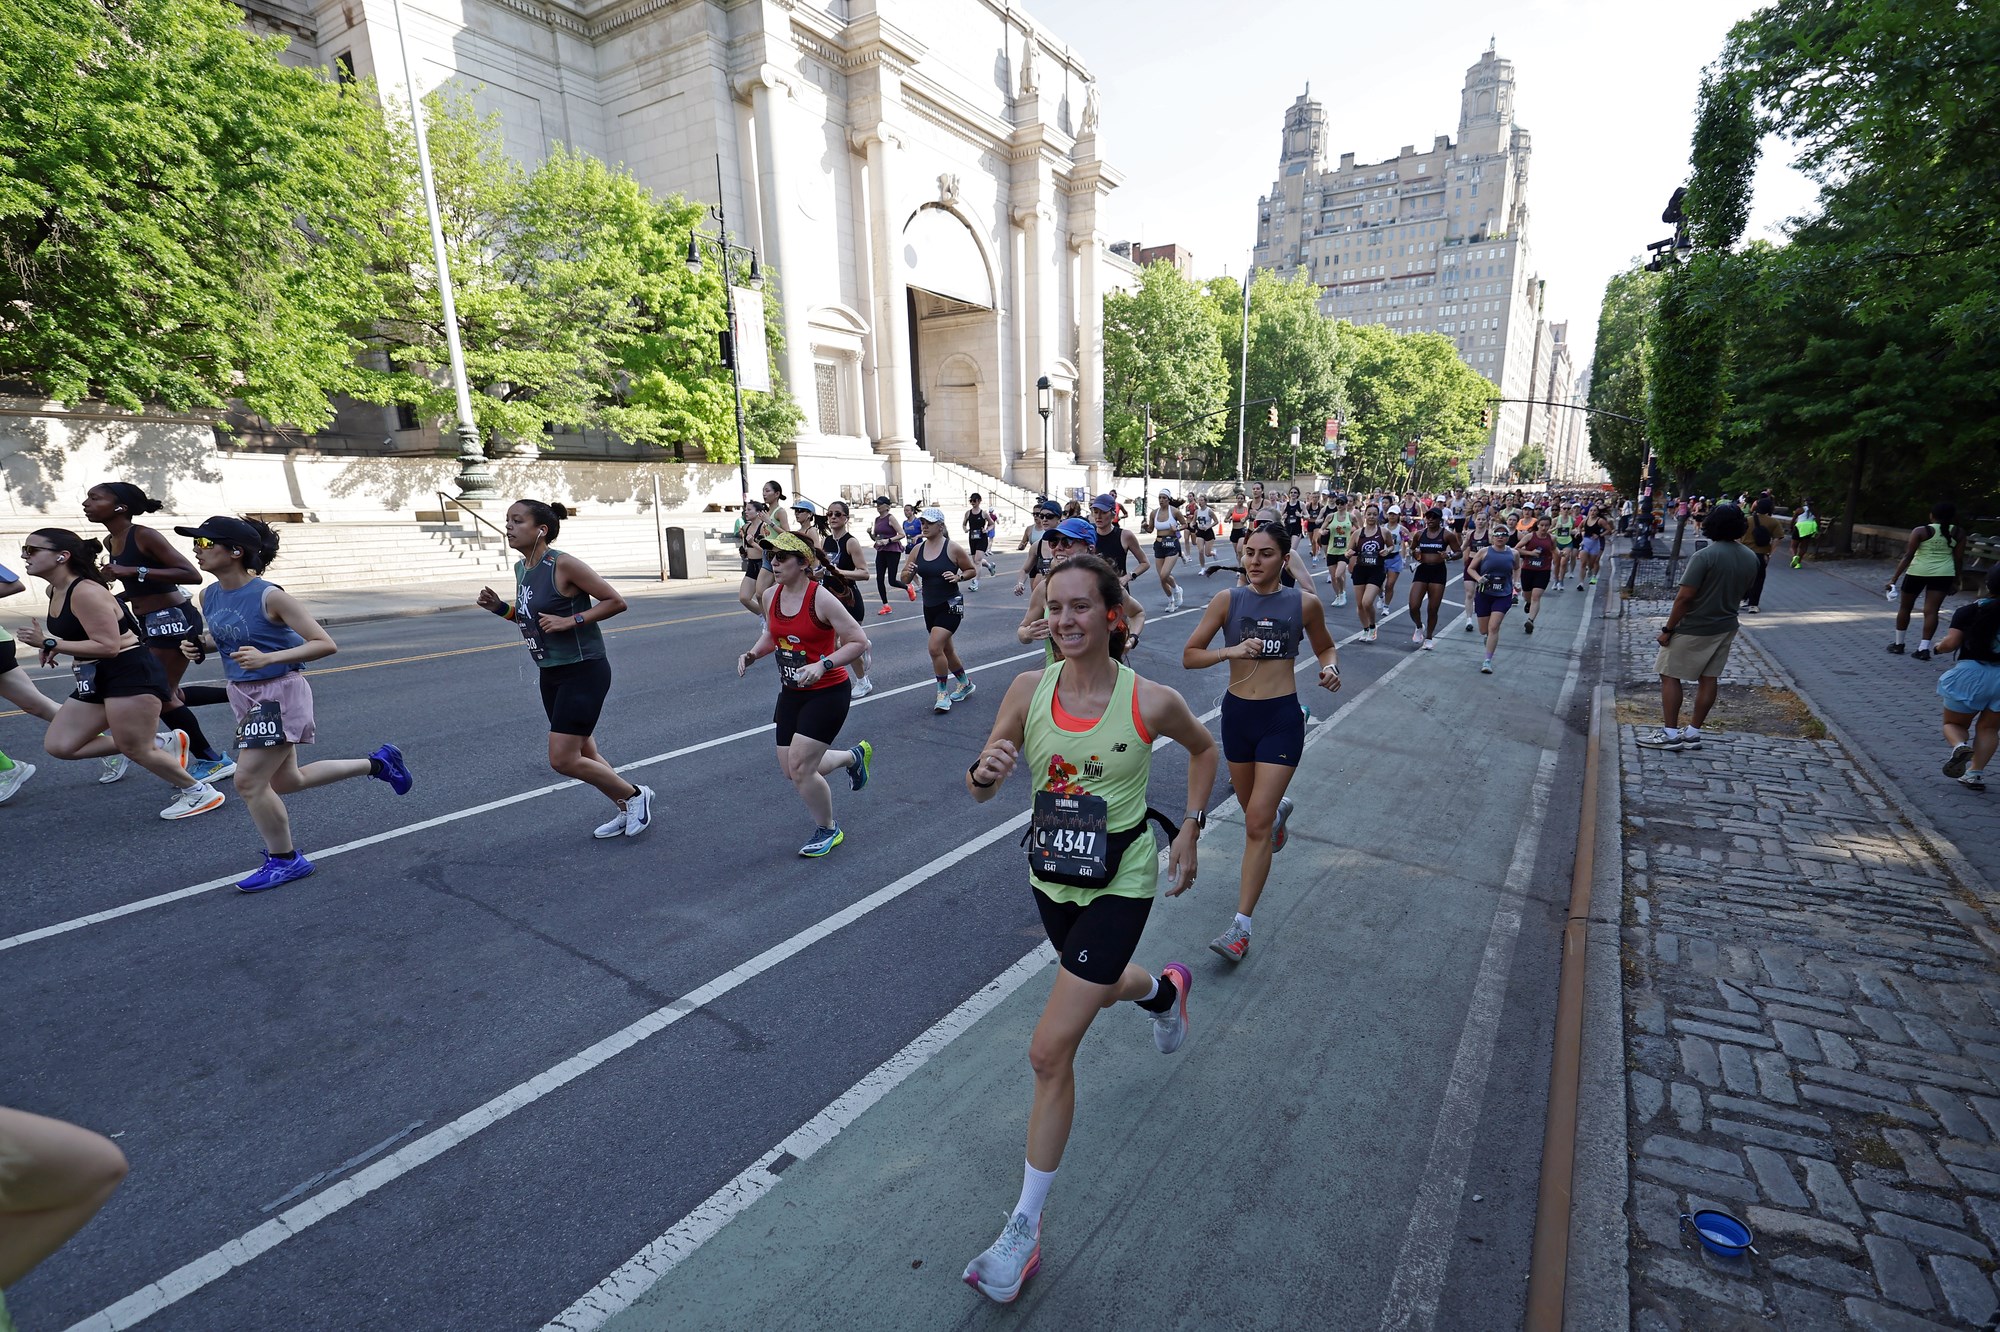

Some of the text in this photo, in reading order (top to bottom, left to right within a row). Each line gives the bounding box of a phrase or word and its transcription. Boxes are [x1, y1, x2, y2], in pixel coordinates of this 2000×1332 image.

[160, 621, 186, 635] 8782
[1262, 639, 1281, 653] 199
[784, 665, 797, 678] 515
[244, 721, 277, 737] 6080
[1082, 763, 1103, 778] MINI
[1060, 798, 1073, 809] MINI
[1053, 828, 1096, 855] 4347
[1043, 863, 1057, 872] 4347
[1078, 867, 1093, 877] 4347
